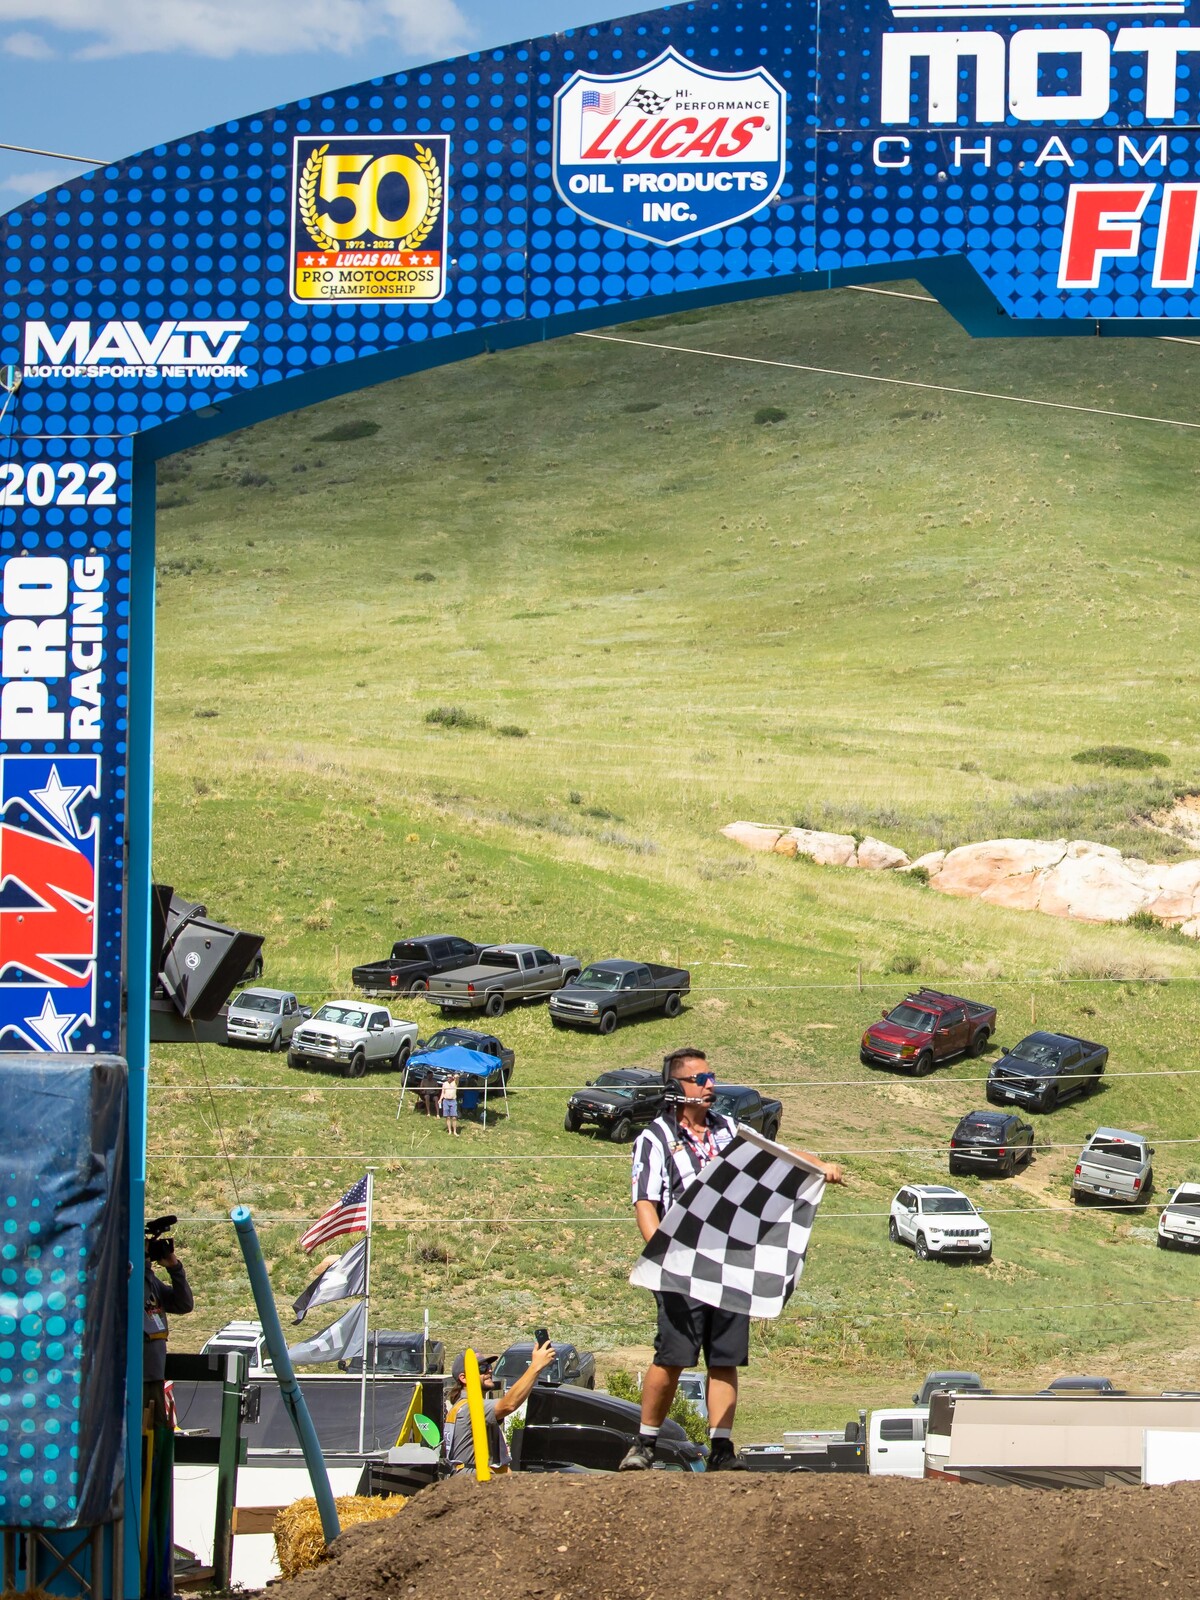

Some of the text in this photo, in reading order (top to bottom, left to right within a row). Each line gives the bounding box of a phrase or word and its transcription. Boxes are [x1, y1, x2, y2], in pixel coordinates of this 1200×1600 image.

[676, 101, 770, 111] PERFORMANCE
[581, 115, 766, 158] LUCAS
[569, 172, 768, 193] OIL PRODUCTS
[315, 154, 429, 240] 50
[345, 241, 365, 249] 1972
[373, 241, 395, 249] 2022
[336, 254, 400, 267] LUCAS OIL
[303, 270, 434, 282] PRO MOTOCROSS
[320, 285, 416, 295] CHAMPIONSHIP
[24, 366, 248, 378] MOTORSPORTS NETWORK
[0, 463, 116, 505] 2022
[1, 557, 68, 740] PRO
[70, 556, 104, 740] RACING
